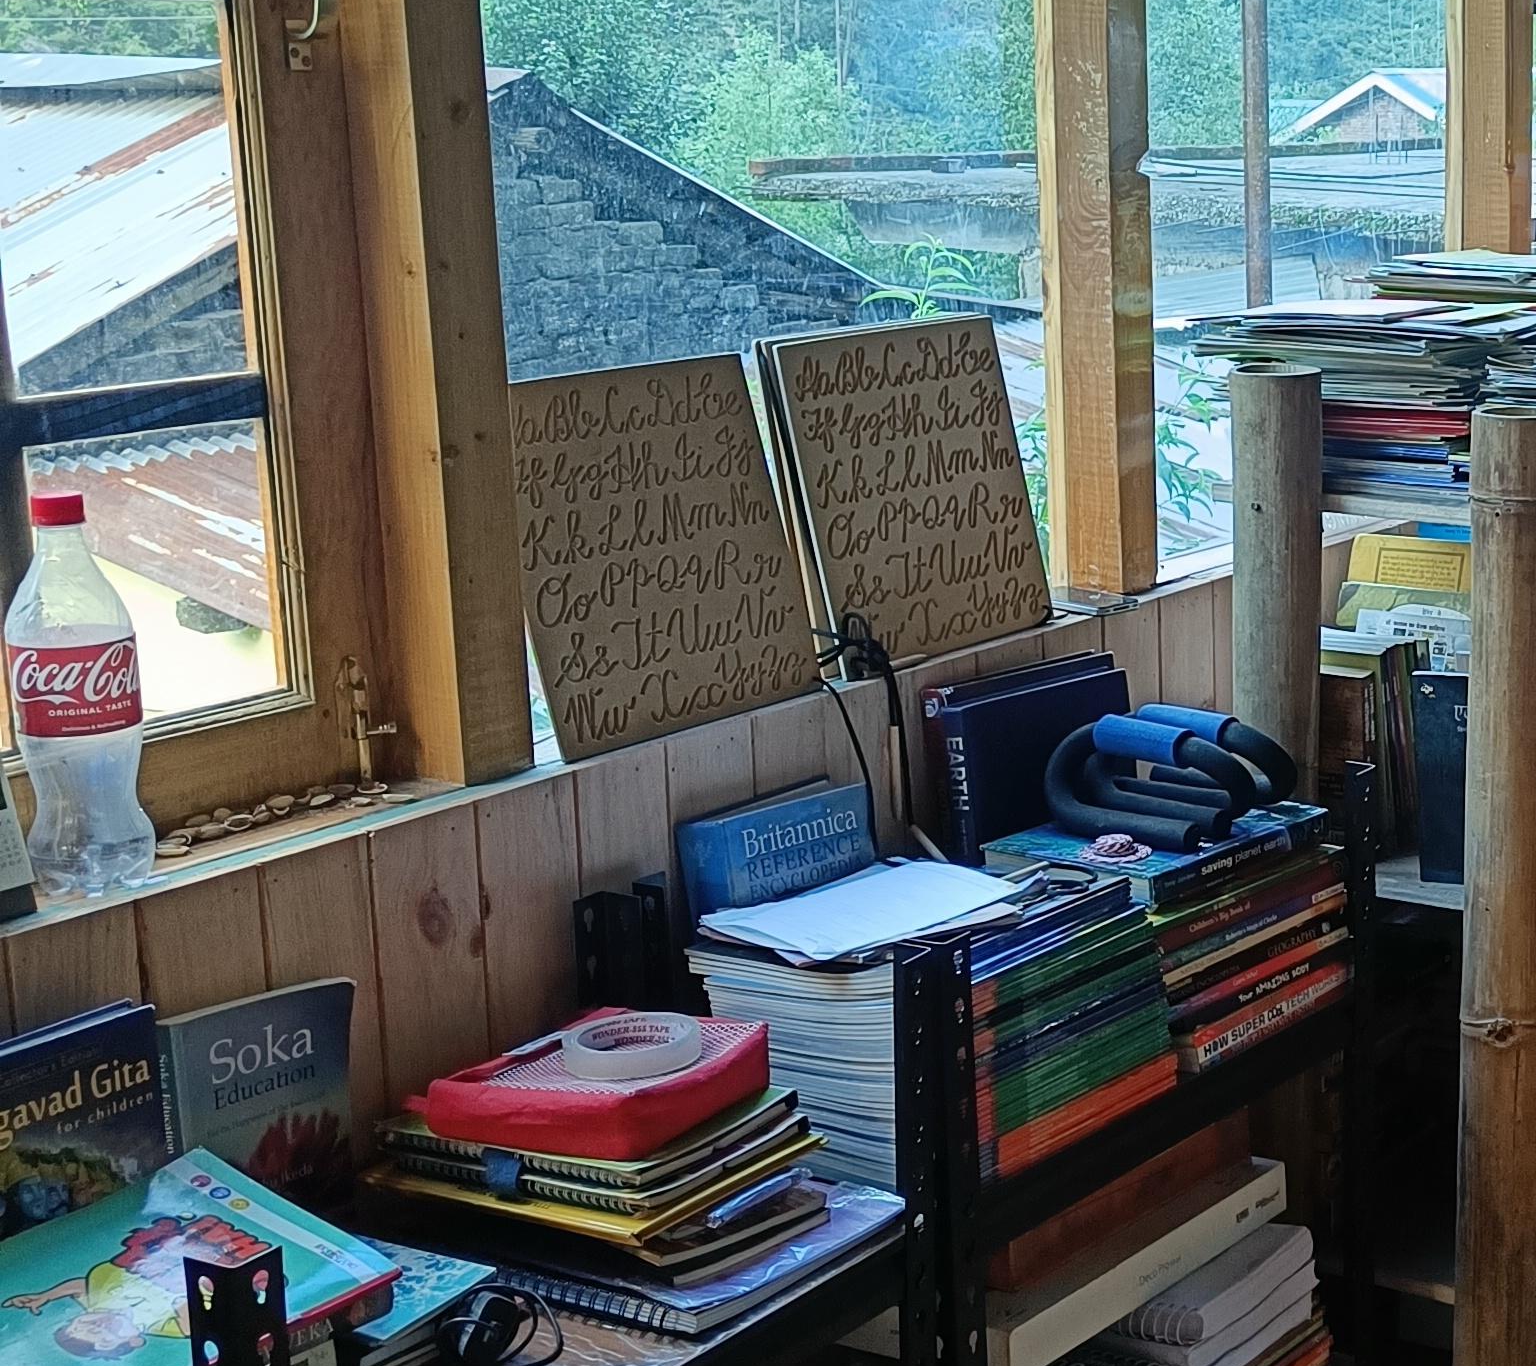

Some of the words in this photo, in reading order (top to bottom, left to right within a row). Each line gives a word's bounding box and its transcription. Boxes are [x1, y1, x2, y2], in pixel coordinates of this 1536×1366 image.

[48, 706, 103, 717] ORIGINAL
[105, 699, 132, 712] TASTE
[945, 735, 971, 812] EARTH
[741, 808, 858, 860] Britannica
[746, 832, 862, 882] REFERENCE
[1201, 855, 1233, 876] saving
[1234, 844, 1262, 864] planet
[1263, 836, 1286, 852] earth
[750, 853, 864, 901] ENCYCLOPEDIA
[1255, 971, 1291, 996] AMAZING
[1291, 963, 1311, 979] BODY
[648, 1024, 671, 1034] TAPE
[1203, 1033, 1230, 1058] HOW
[1231, 1012, 1267, 1043] SUPER
[1286, 987, 1311, 1012] TECH
[158, 1053, 169, 1090] Soka
[209, 1023, 315, 1085] Soka
[90, 1058, 152, 1099] Gita
[213, 1064, 316, 1111] Education
[56, 1120, 81, 1134] for
[87, 1091, 154, 1124] children
[161, 1093, 177, 1155] Education
